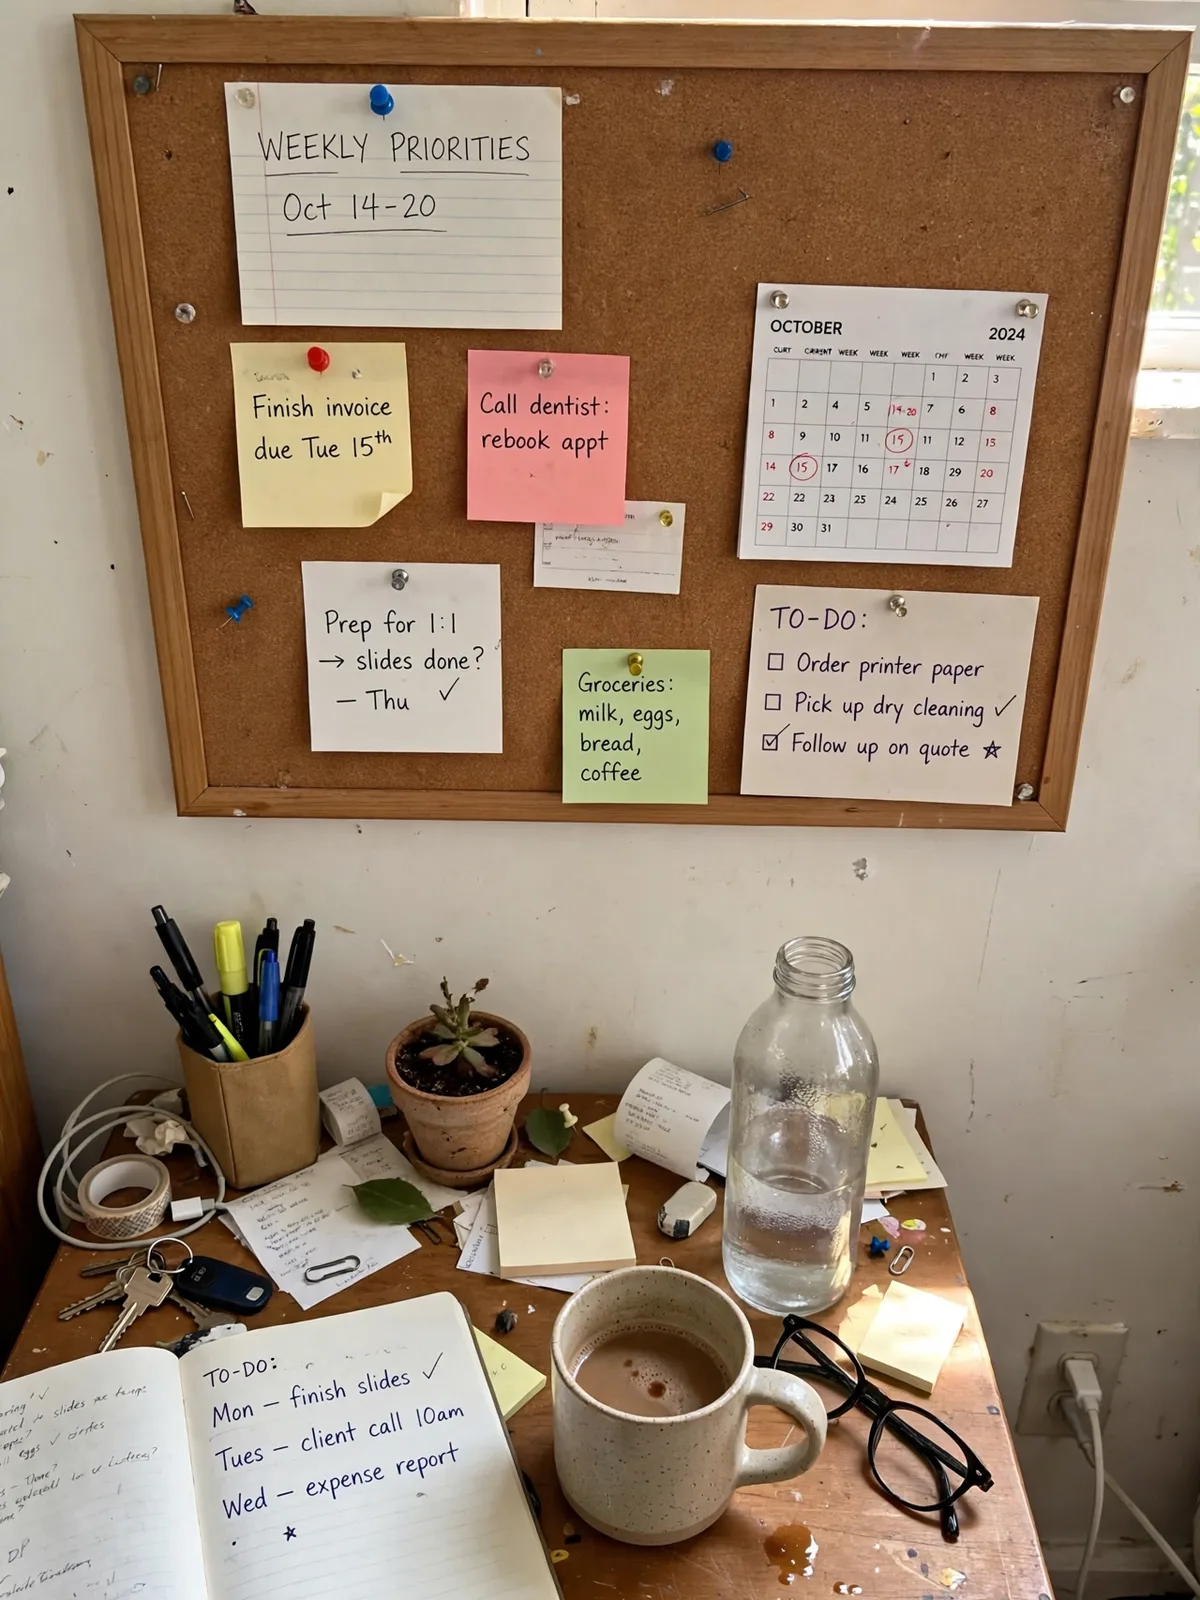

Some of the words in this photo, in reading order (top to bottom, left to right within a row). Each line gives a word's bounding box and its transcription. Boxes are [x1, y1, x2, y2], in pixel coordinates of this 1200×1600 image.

[257, 130, 369, 164] WEEKLY
[390, 131, 530, 163] PRIORITIES
[283, 192, 332, 222] Oct
[352, 192, 436, 221] 14-20
[770, 319, 843, 336] OCTOBER
[988, 327, 1026, 341] 2024
[931, 371, 936, 382] 1
[961, 372, 969, 383] 2
[992, 374, 1000, 384] 3
[252, 393, 314, 419] Finish
[326, 396, 393, 417] invoice
[480, 391, 517, 414] Call
[529, 392, 609, 416] dentist:
[771, 398, 775, 408] 1
[801, 398, 808, 409] 2
[831, 400, 839, 410] 4
[863, 401, 871, 412] 5
[927, 403, 934, 413] 7
[958, 405, 966, 415] 6
[989, 406, 997, 416] 8
[254, 435, 293, 460] due
[301, 435, 341, 459] Tue
[352, 429, 392, 458] 15th
[481, 427, 551, 450] rebook
[561, 430, 609, 459] appt
[768, 429, 775, 440] 8
[799, 431, 806, 441] 9
[829, 432, 841, 442] 10
[861, 433, 870, 443] 11
[892, 433, 905, 446] 15
[923, 435, 932, 445] 11
[954, 436, 965, 446] 12
[766, 461, 776, 471] 14
[796, 461, 808, 473] 15
[826, 463, 838, 473] 17
[858, 464, 869, 474] 16
[889, 465, 900, 475] 17
[919, 466, 930, 476] 18
[948, 467, 962, 477] 29
[979, 468, 994, 478] 20
[762, 491, 775, 502] 22
[793, 492, 806, 503] 22
[823, 493, 835, 504] 23
[853, 494, 867, 505] 25
[884, 495, 897, 505] 24
[914, 496, 928, 507] 25
[945, 497, 958, 508] 26
[976, 498, 989, 509] 27
[760, 521, 774, 532] 29
[790, 522, 804, 532] 30
[820, 523, 831, 533] 31
[324, 609, 372, 643] Prep
[383, 609, 416, 634] for
[430, 612, 456, 634] 1:1
[769, 606, 867, 631] TO-DO:
[356, 648, 413, 671] slides
[423, 645, 485, 670] done?
[797, 651, 851, 673] Order
[859, 655, 923, 682] printer
[931, 663, 985, 685] paper
[578, 671, 673, 693] Groceries:
[365, 688, 410, 711] Thu
[795, 691, 832, 713] Pick
[842, 701, 864, 722] up
[873, 694, 904, 724] dry
[913, 696, 985, 728] cleaning
[579, 702, 624, 726] milk,
[632, 708, 680, 731] eggs,
[580, 732, 641, 756] bread,
[792, 731, 847, 753] Follow
[857, 742, 879, 763] up
[888, 742, 909, 755] on
[919, 738, 970, 765] quote
[580, 761, 642, 782] coffee
[202, 1357, 278, 1388] TO-DO:
[213, 1402, 254, 1429] Mon
[289, 1379, 347, 1409] finish
[357, 1369, 411, 1395] slides
[214, 1446, 264, 1472] Tues
[301, 1421, 357, 1452] client
[368, 1411, 403, 1438] call
[416, 1406, 465, 1428] 10am
[222, 1485, 268, 1519] Wed
[305, 1466, 385, 1500] expense
[395, 1441, 459, 1479] report
